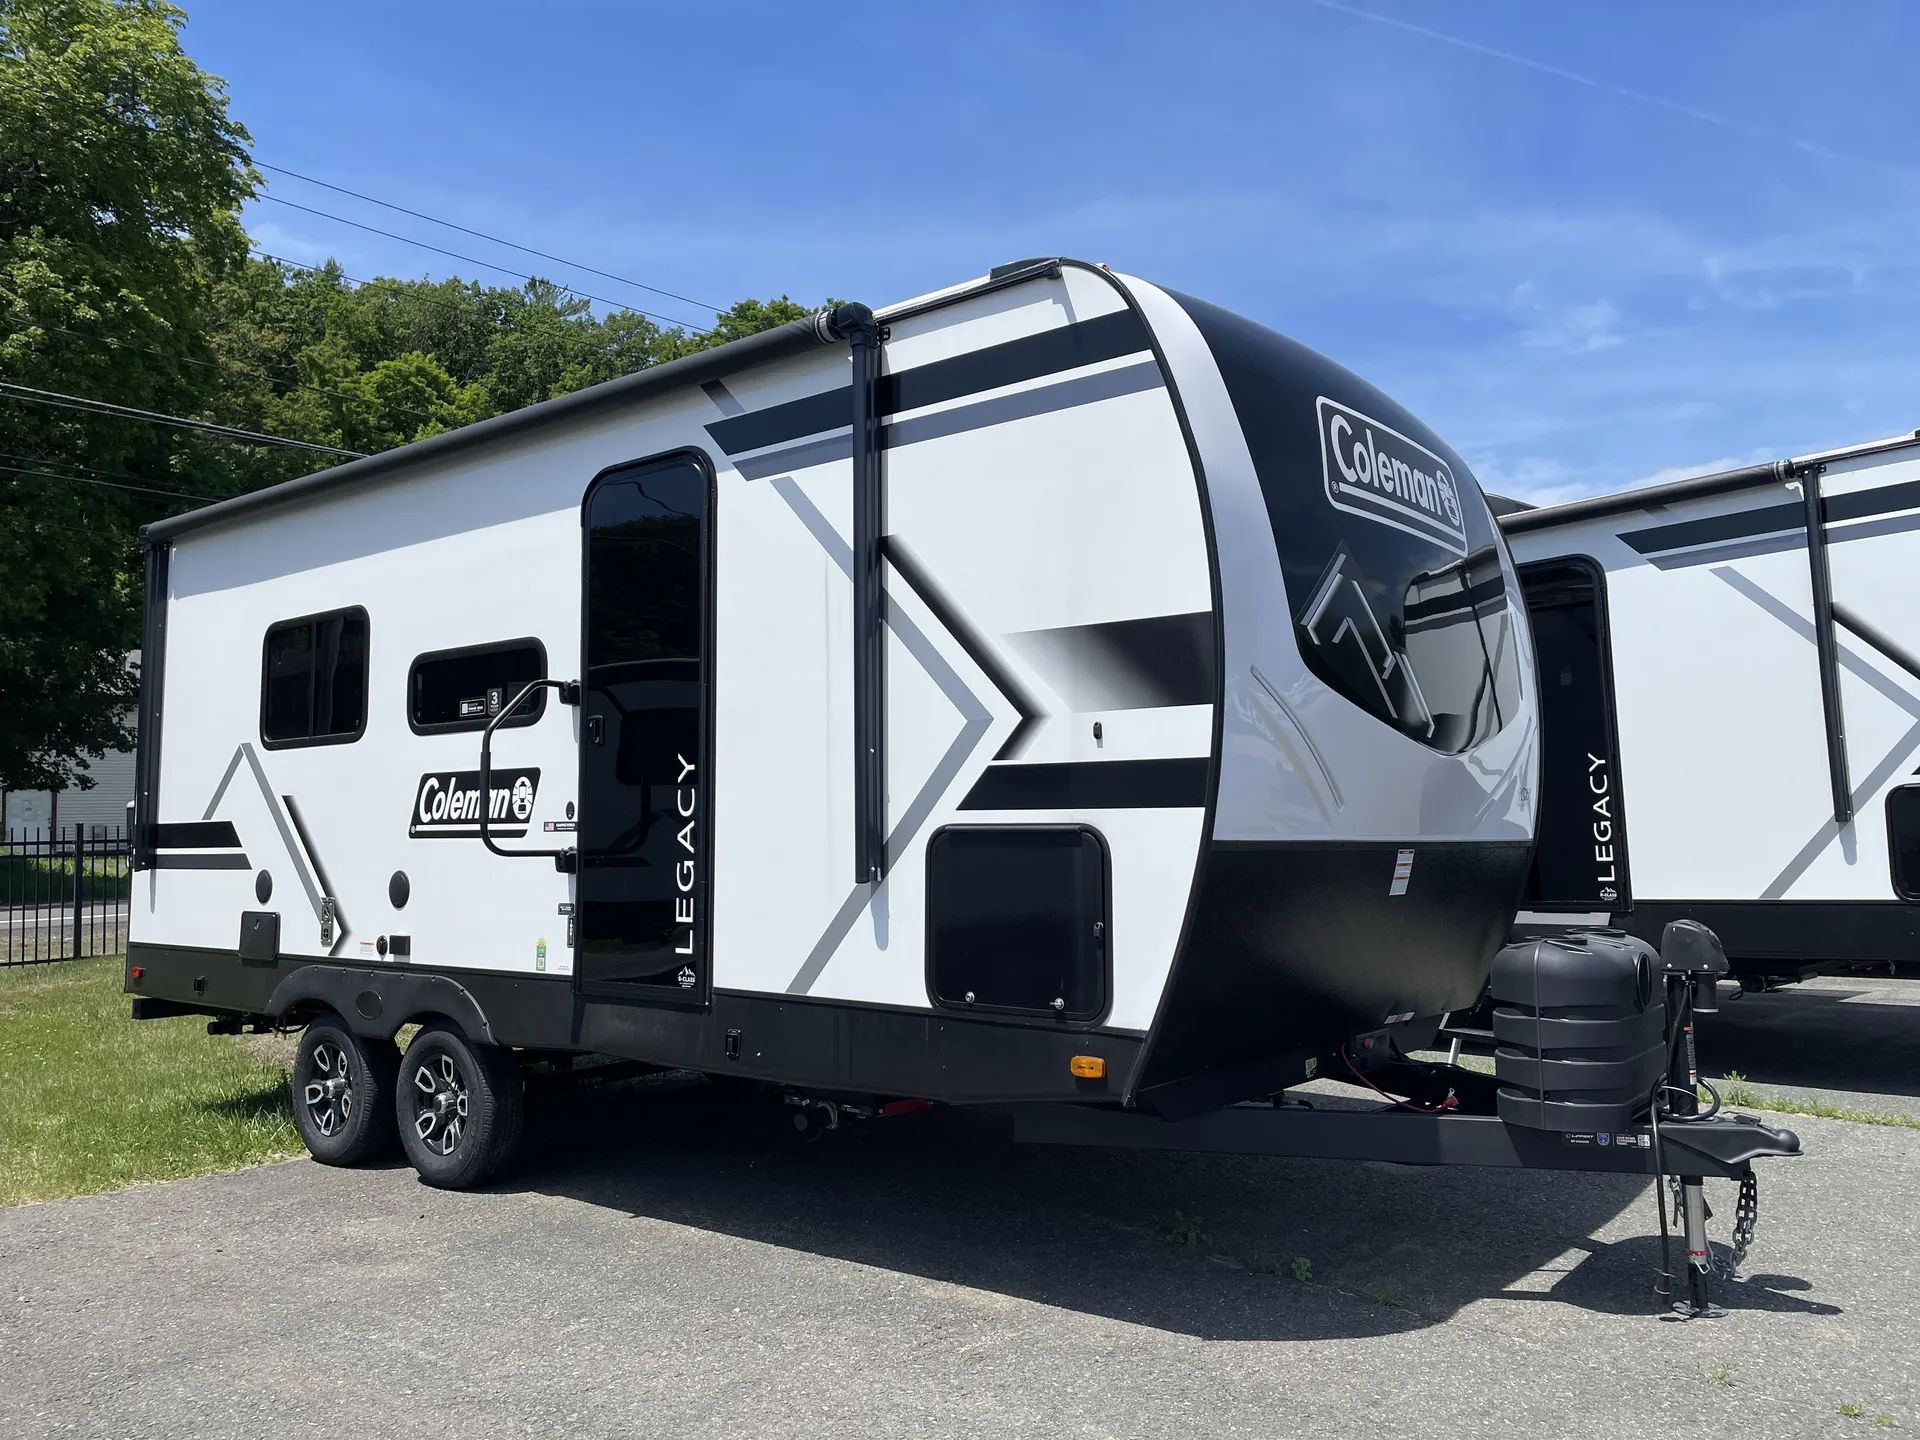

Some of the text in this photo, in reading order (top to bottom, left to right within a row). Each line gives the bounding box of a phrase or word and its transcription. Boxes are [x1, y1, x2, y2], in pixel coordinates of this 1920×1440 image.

[1331, 414, 1442, 516] Coleman
[491, 691, 498, 705] 3
[675, 753, 696, 955] LEGACY
[1587, 752, 1616, 882] LEGACY
